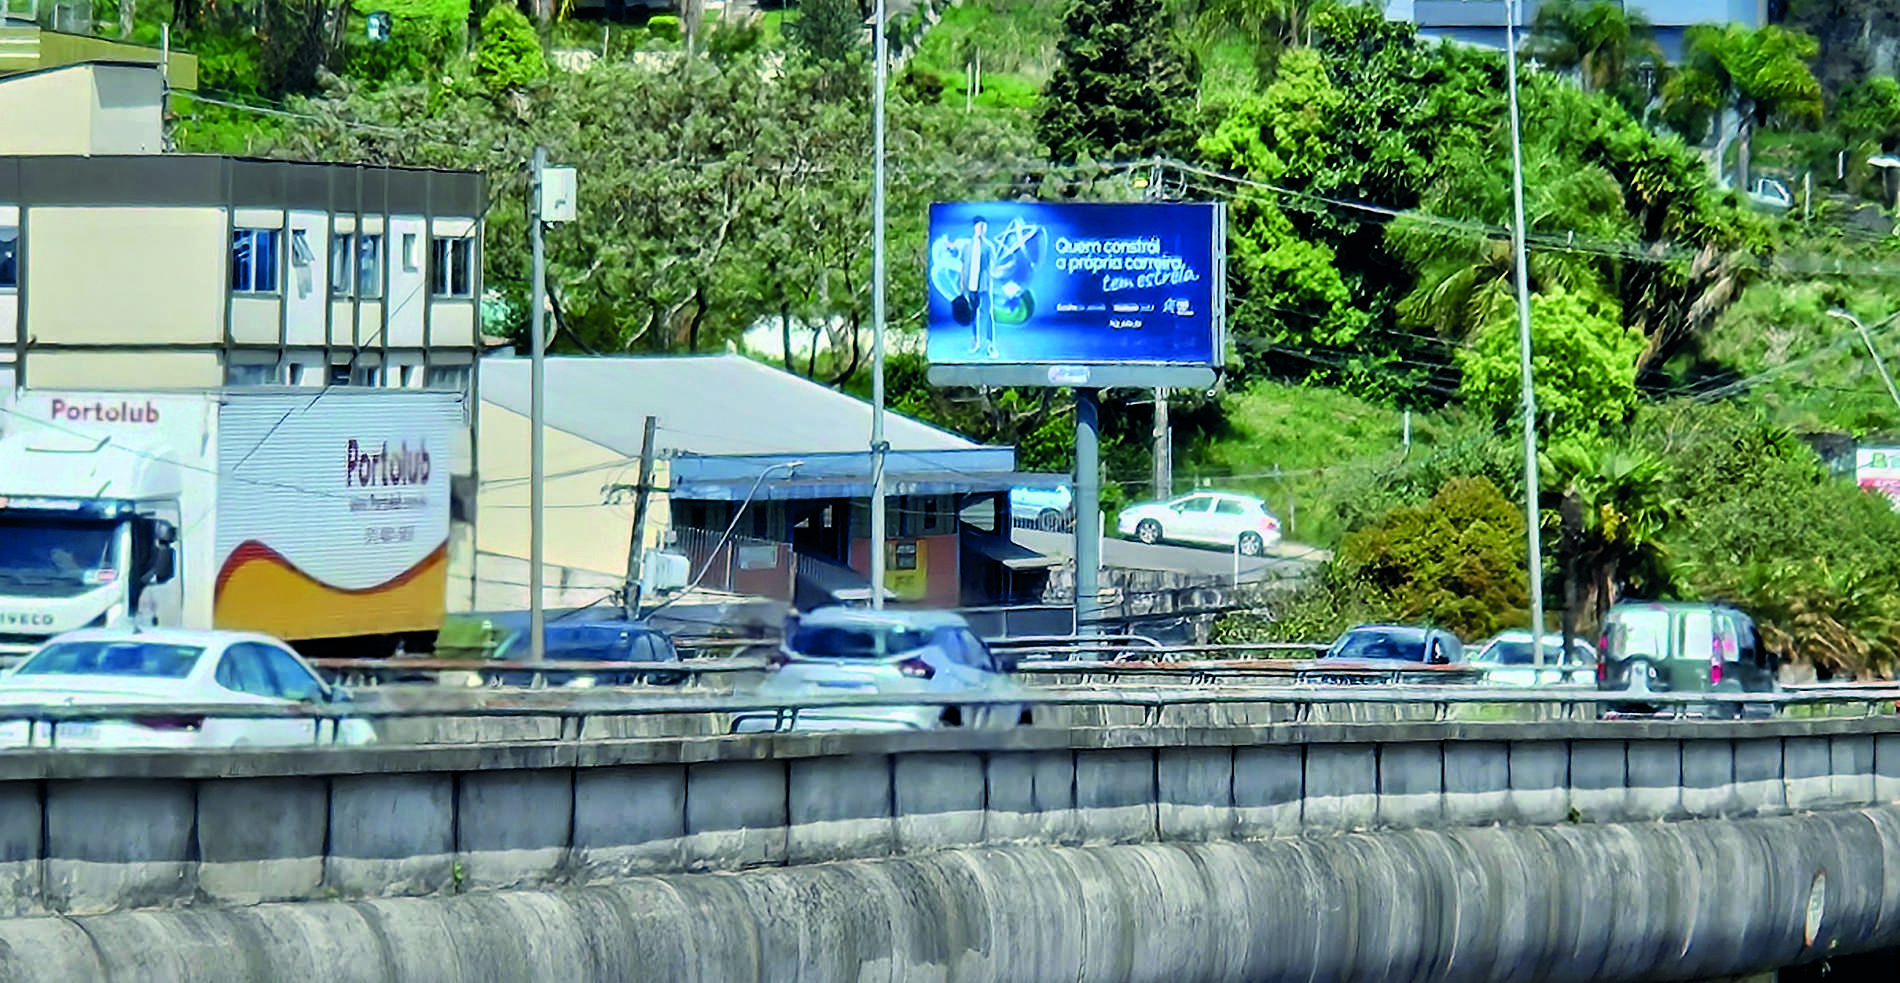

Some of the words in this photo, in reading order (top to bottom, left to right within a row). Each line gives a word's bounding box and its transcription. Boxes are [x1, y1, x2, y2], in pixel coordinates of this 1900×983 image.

[1056, 237, 1101, 254] Quem
[1056, 258, 1066, 270] a
[1068, 254, 1122, 274] própria
[1103, 274, 1134, 292] tem
[51, 398, 160, 423] Portolub
[347, 438, 431, 487] Portolub
[0, 612, 54, 626] IVECO
